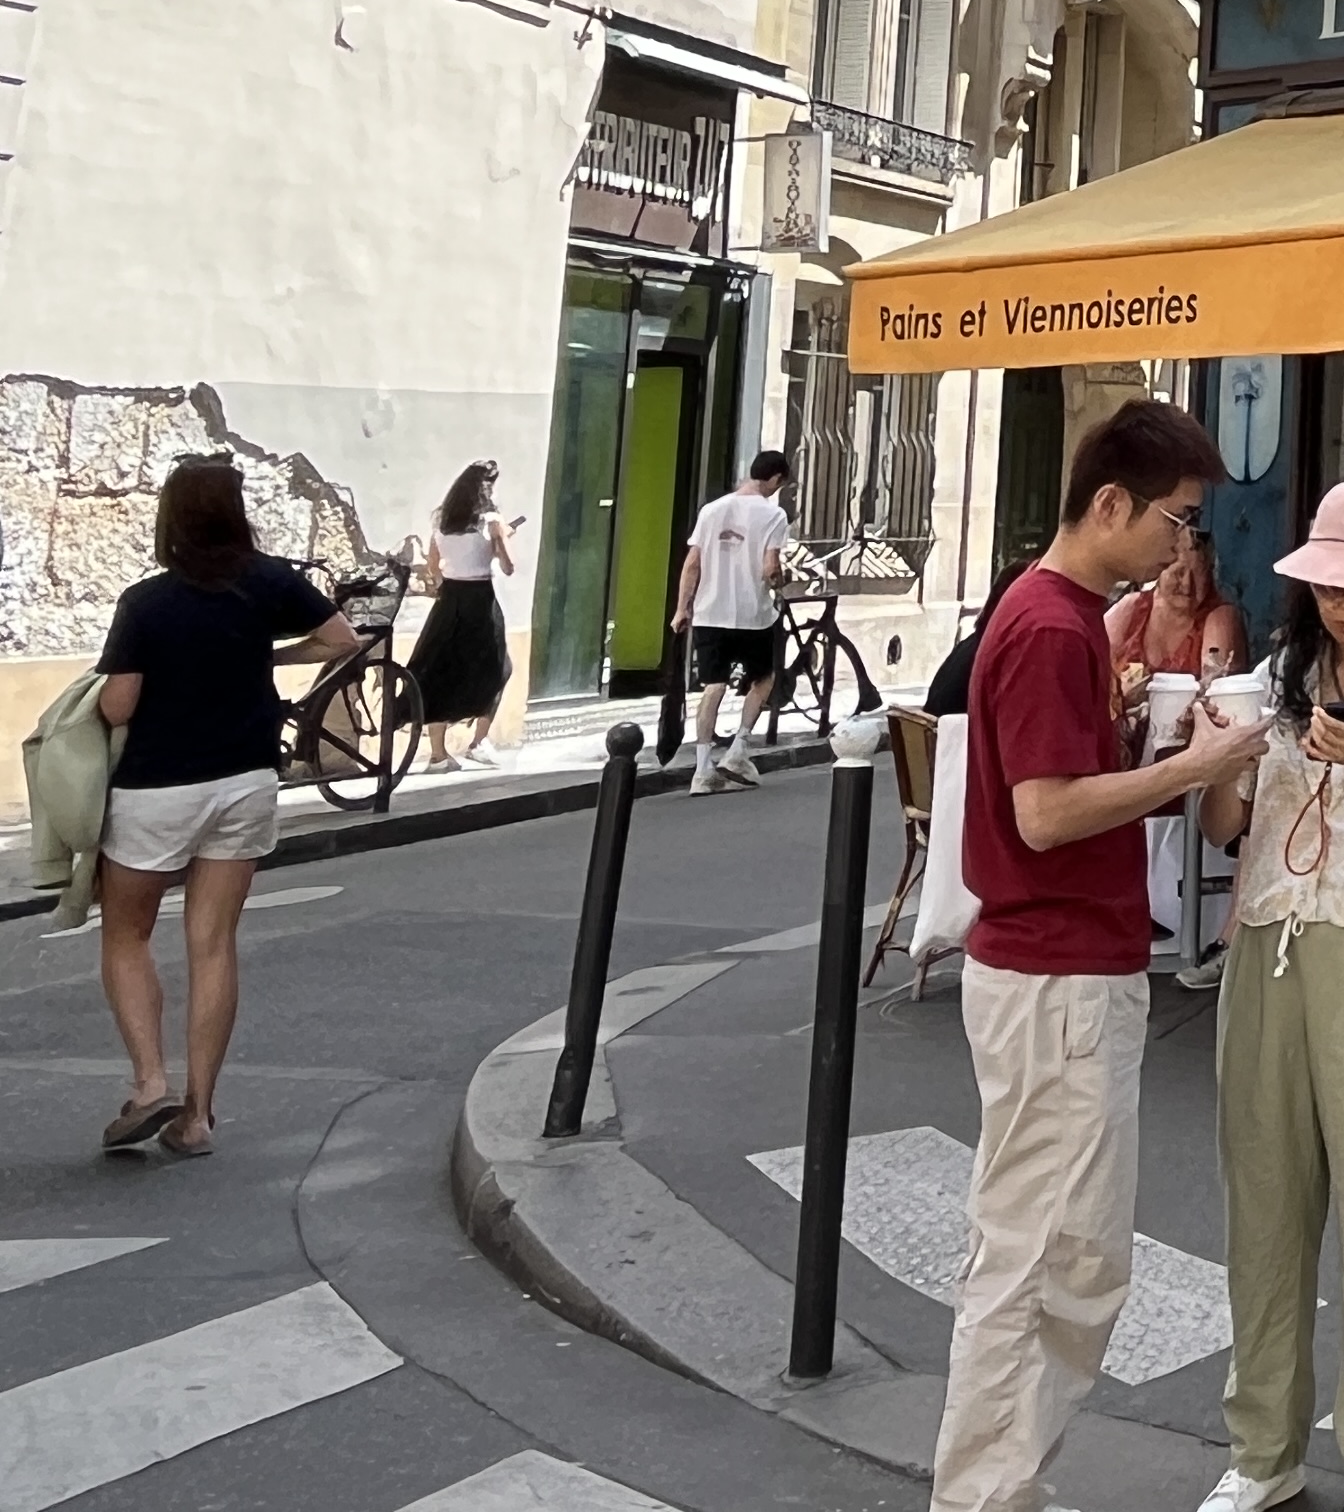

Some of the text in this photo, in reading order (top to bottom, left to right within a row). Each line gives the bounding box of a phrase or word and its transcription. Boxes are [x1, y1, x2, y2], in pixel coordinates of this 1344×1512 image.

[879, 289, 1200, 343] Pains et Viennoiseries
